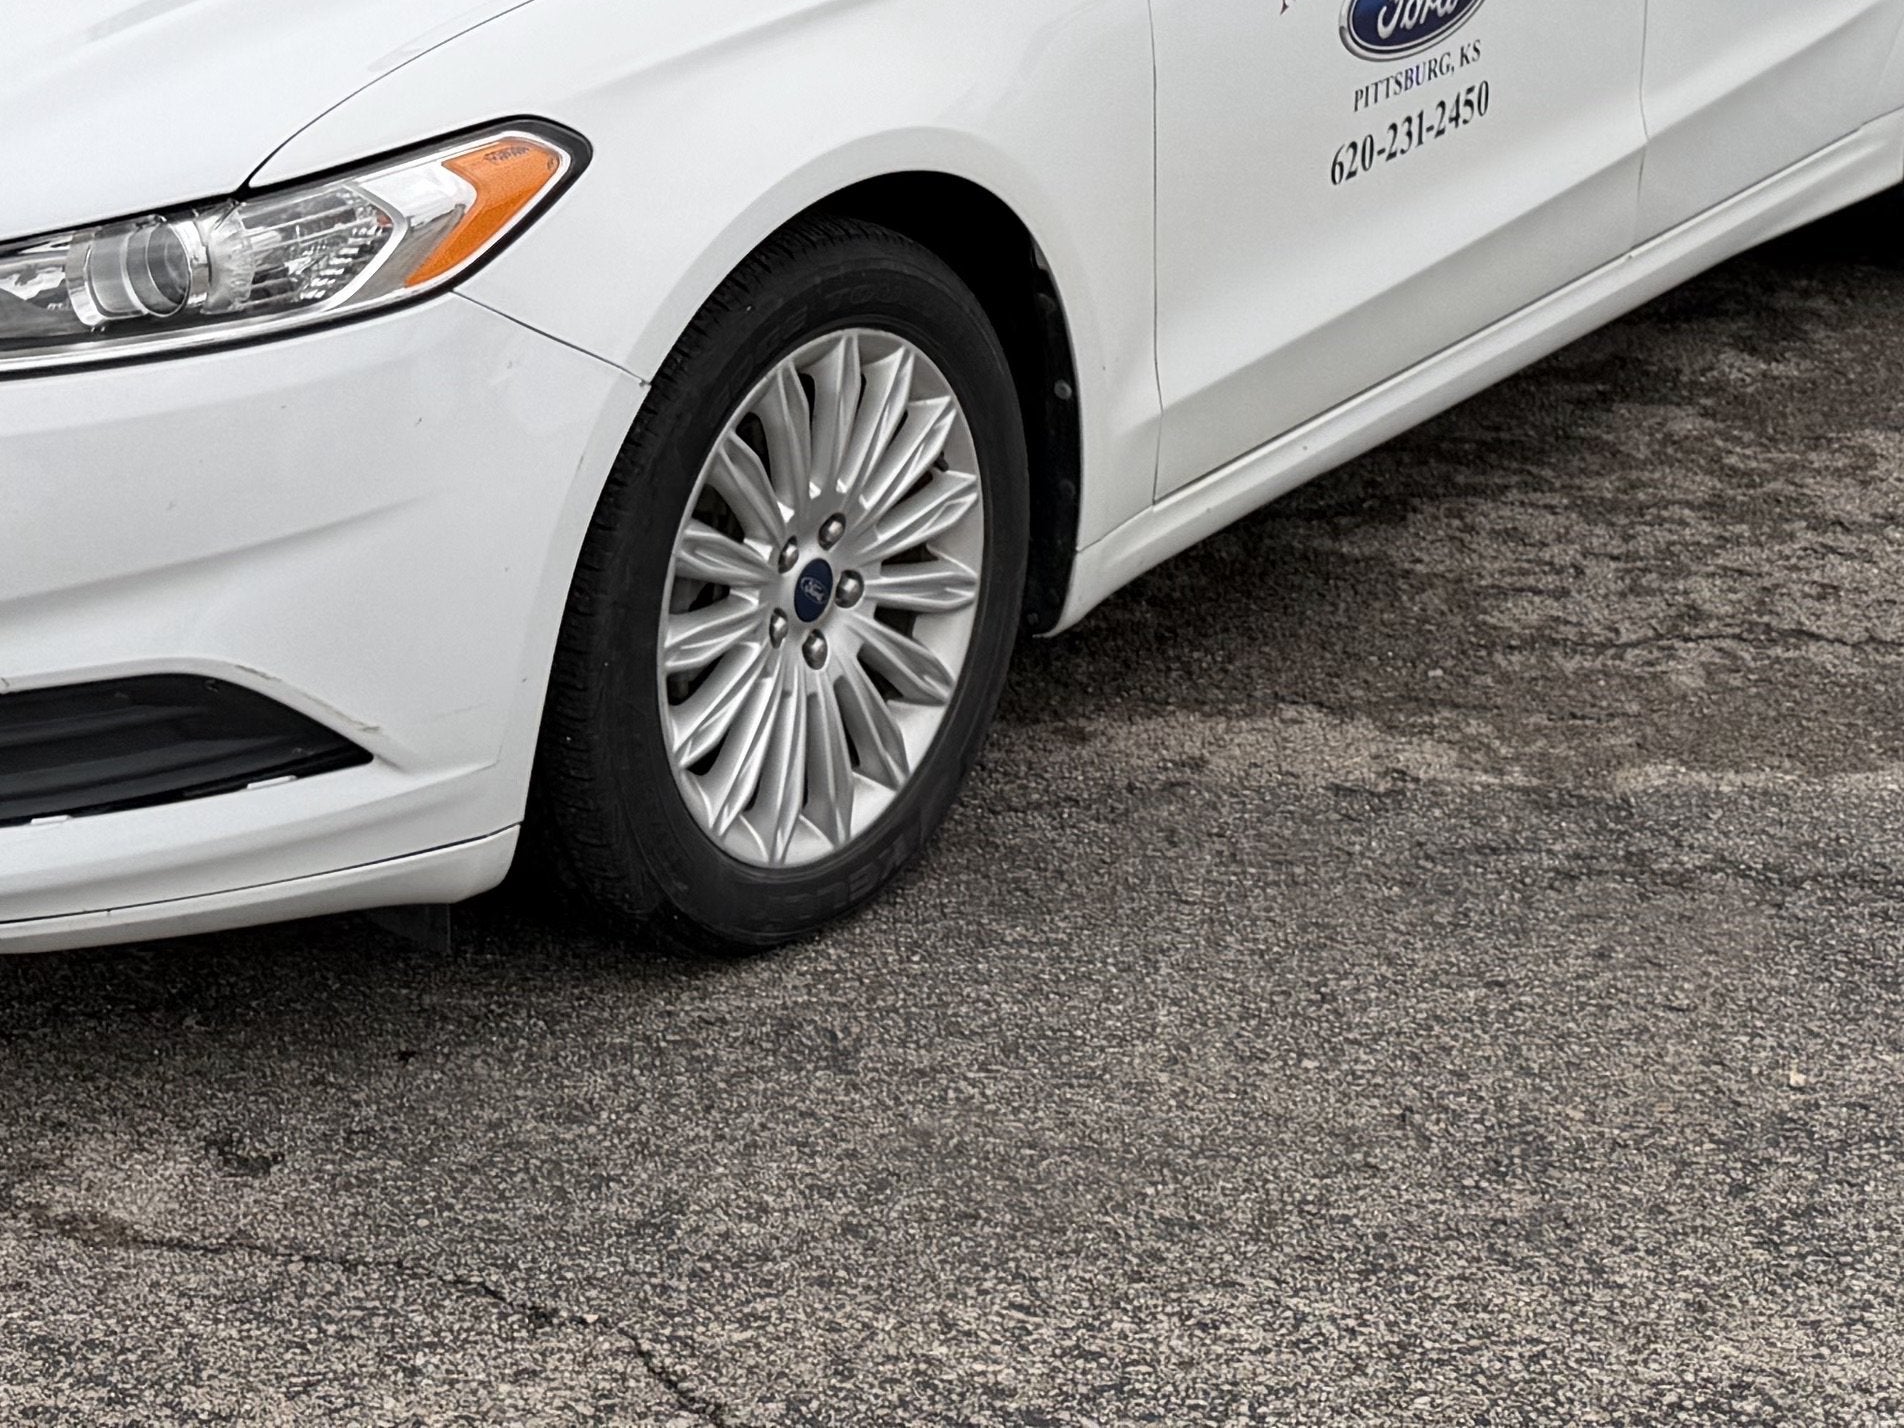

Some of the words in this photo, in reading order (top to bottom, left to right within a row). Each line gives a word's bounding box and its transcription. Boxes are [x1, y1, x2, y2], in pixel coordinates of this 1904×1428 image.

[1353, 52, 1455, 113] PITTSBURG,
[1459, 39, 1482, 68] KS
[1331, 79, 1489, 185] 620-231-2450
